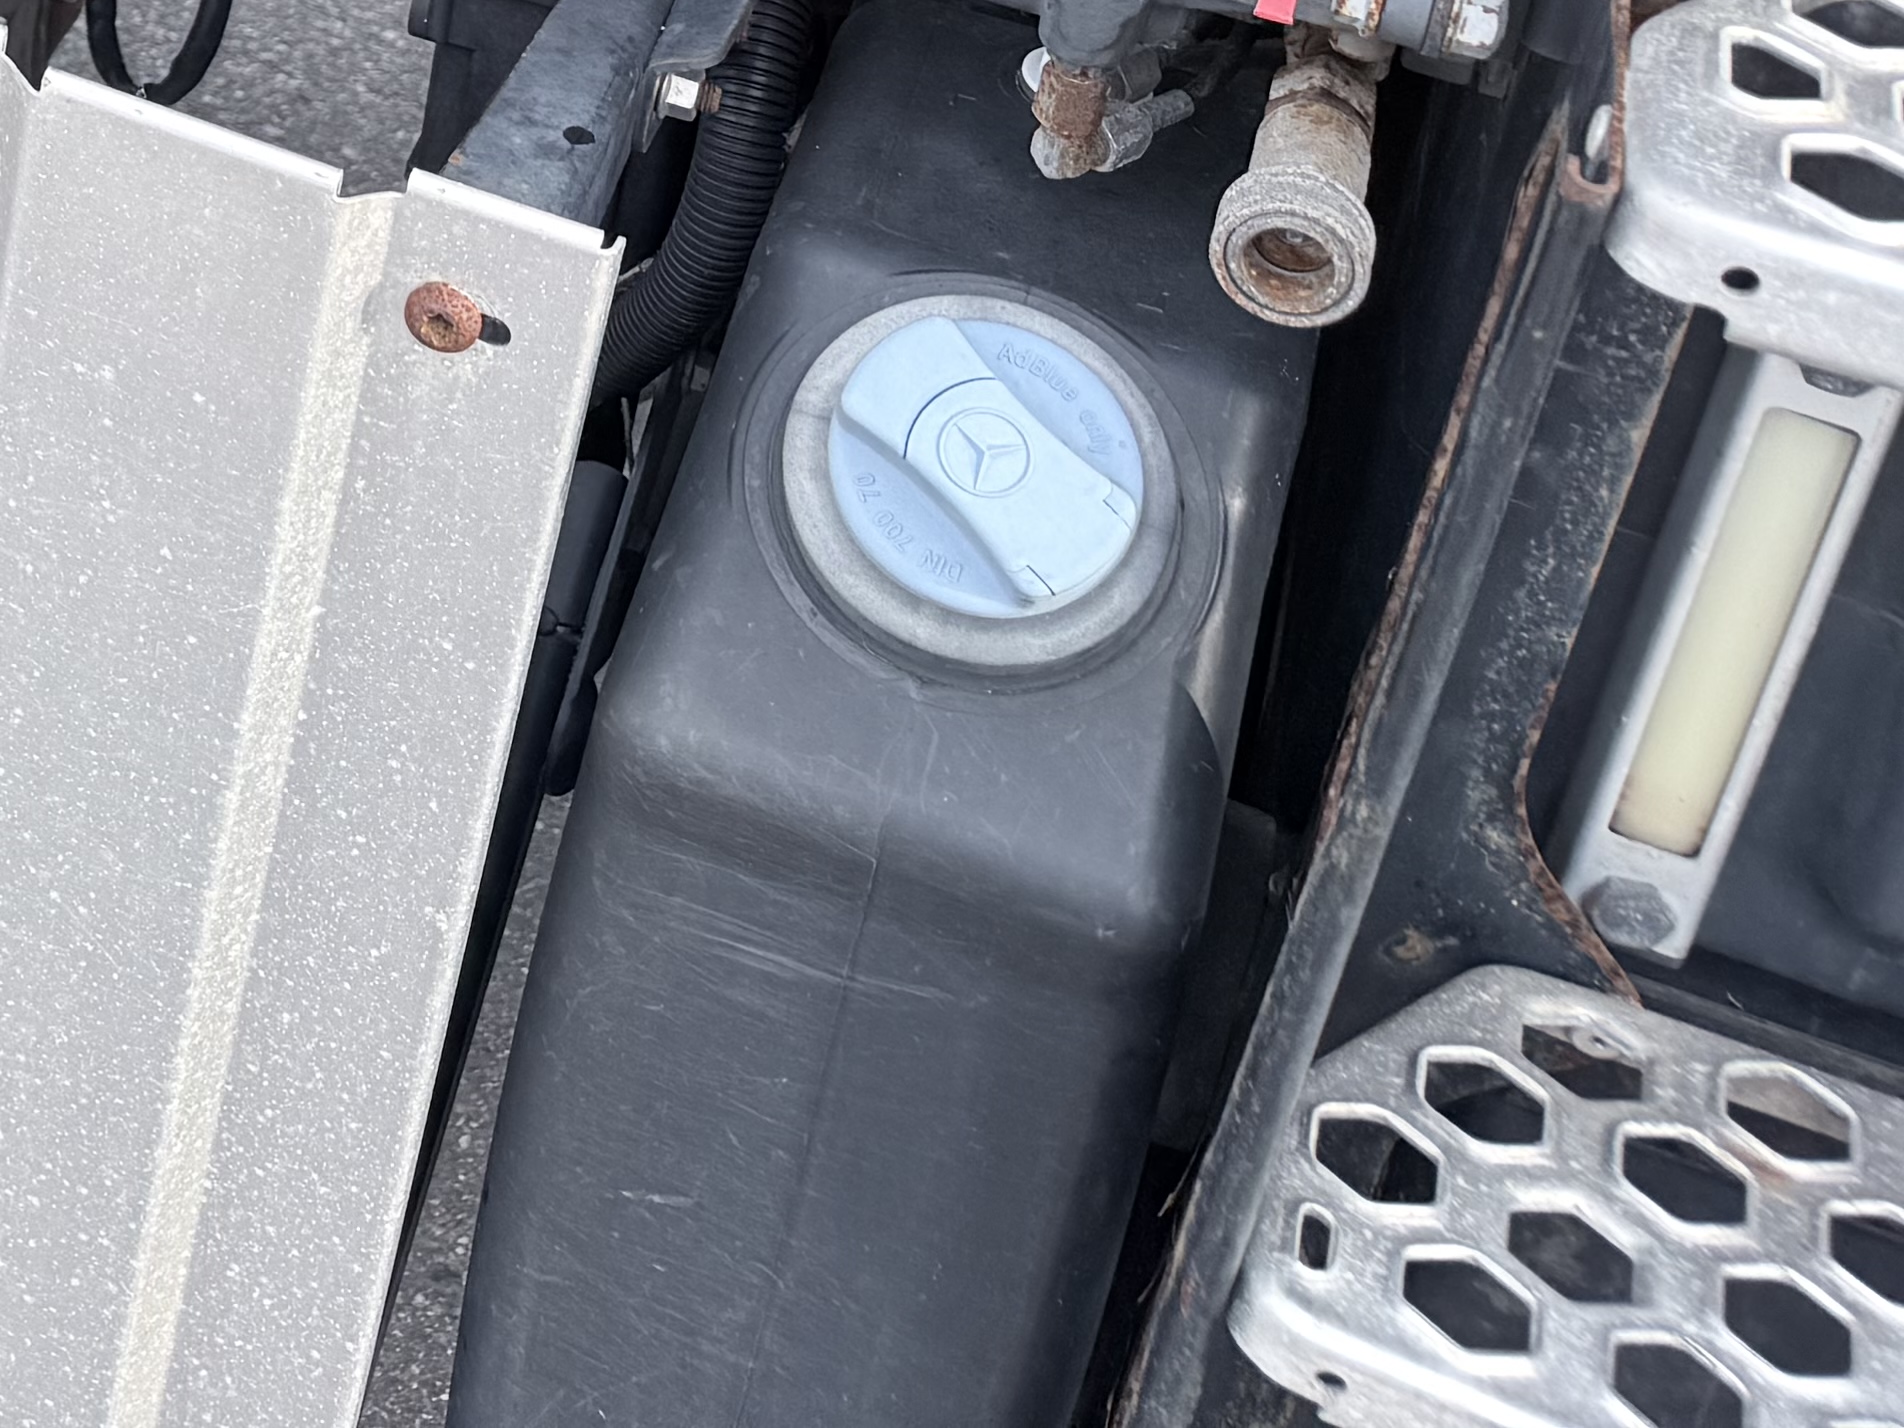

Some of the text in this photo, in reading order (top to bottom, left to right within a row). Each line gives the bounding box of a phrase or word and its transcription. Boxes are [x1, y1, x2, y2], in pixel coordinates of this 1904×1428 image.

[997, 343, 1112, 456] AdBlue only
[853, 472, 963, 582] DIN 700 70
